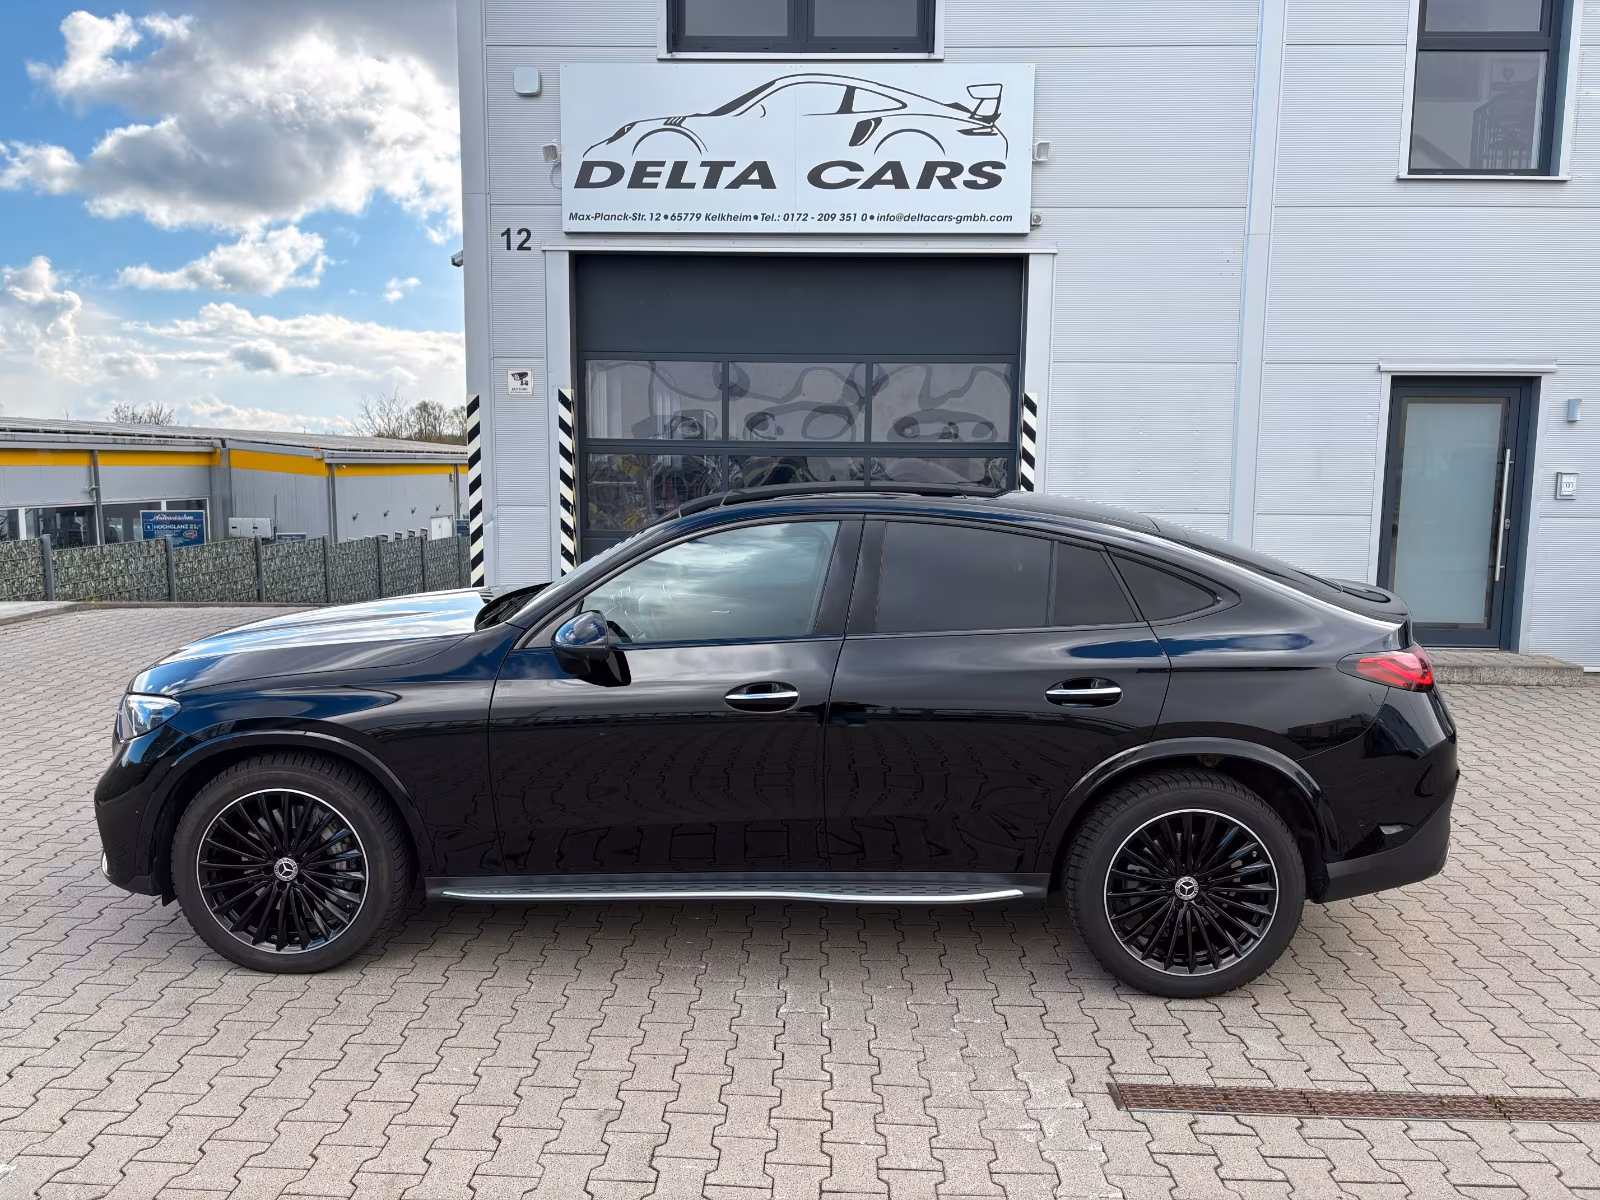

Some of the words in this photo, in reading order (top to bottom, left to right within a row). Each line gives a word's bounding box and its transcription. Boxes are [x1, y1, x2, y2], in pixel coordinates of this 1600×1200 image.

[573, 160, 777, 190] DELTA
[806, 160, 1007, 190] CARS
[568, 212, 647, 222] Max-Planck-Str.
[649, 212, 662, 222] 12
[669, 212, 702, 222] 65779
[704, 212, 752, 222] Kelkheim
[760, 212, 781, 222] Tel.:
[782, 212, 809, 222] 0172
[816, 212, 837, 222] 209
[838, 212, 857, 222] 351
[860, 212, 868, 222] 0
[876, 212, 1013, 225] info@deltacars-gmbh.com
[500, 227, 532, 251] 12
